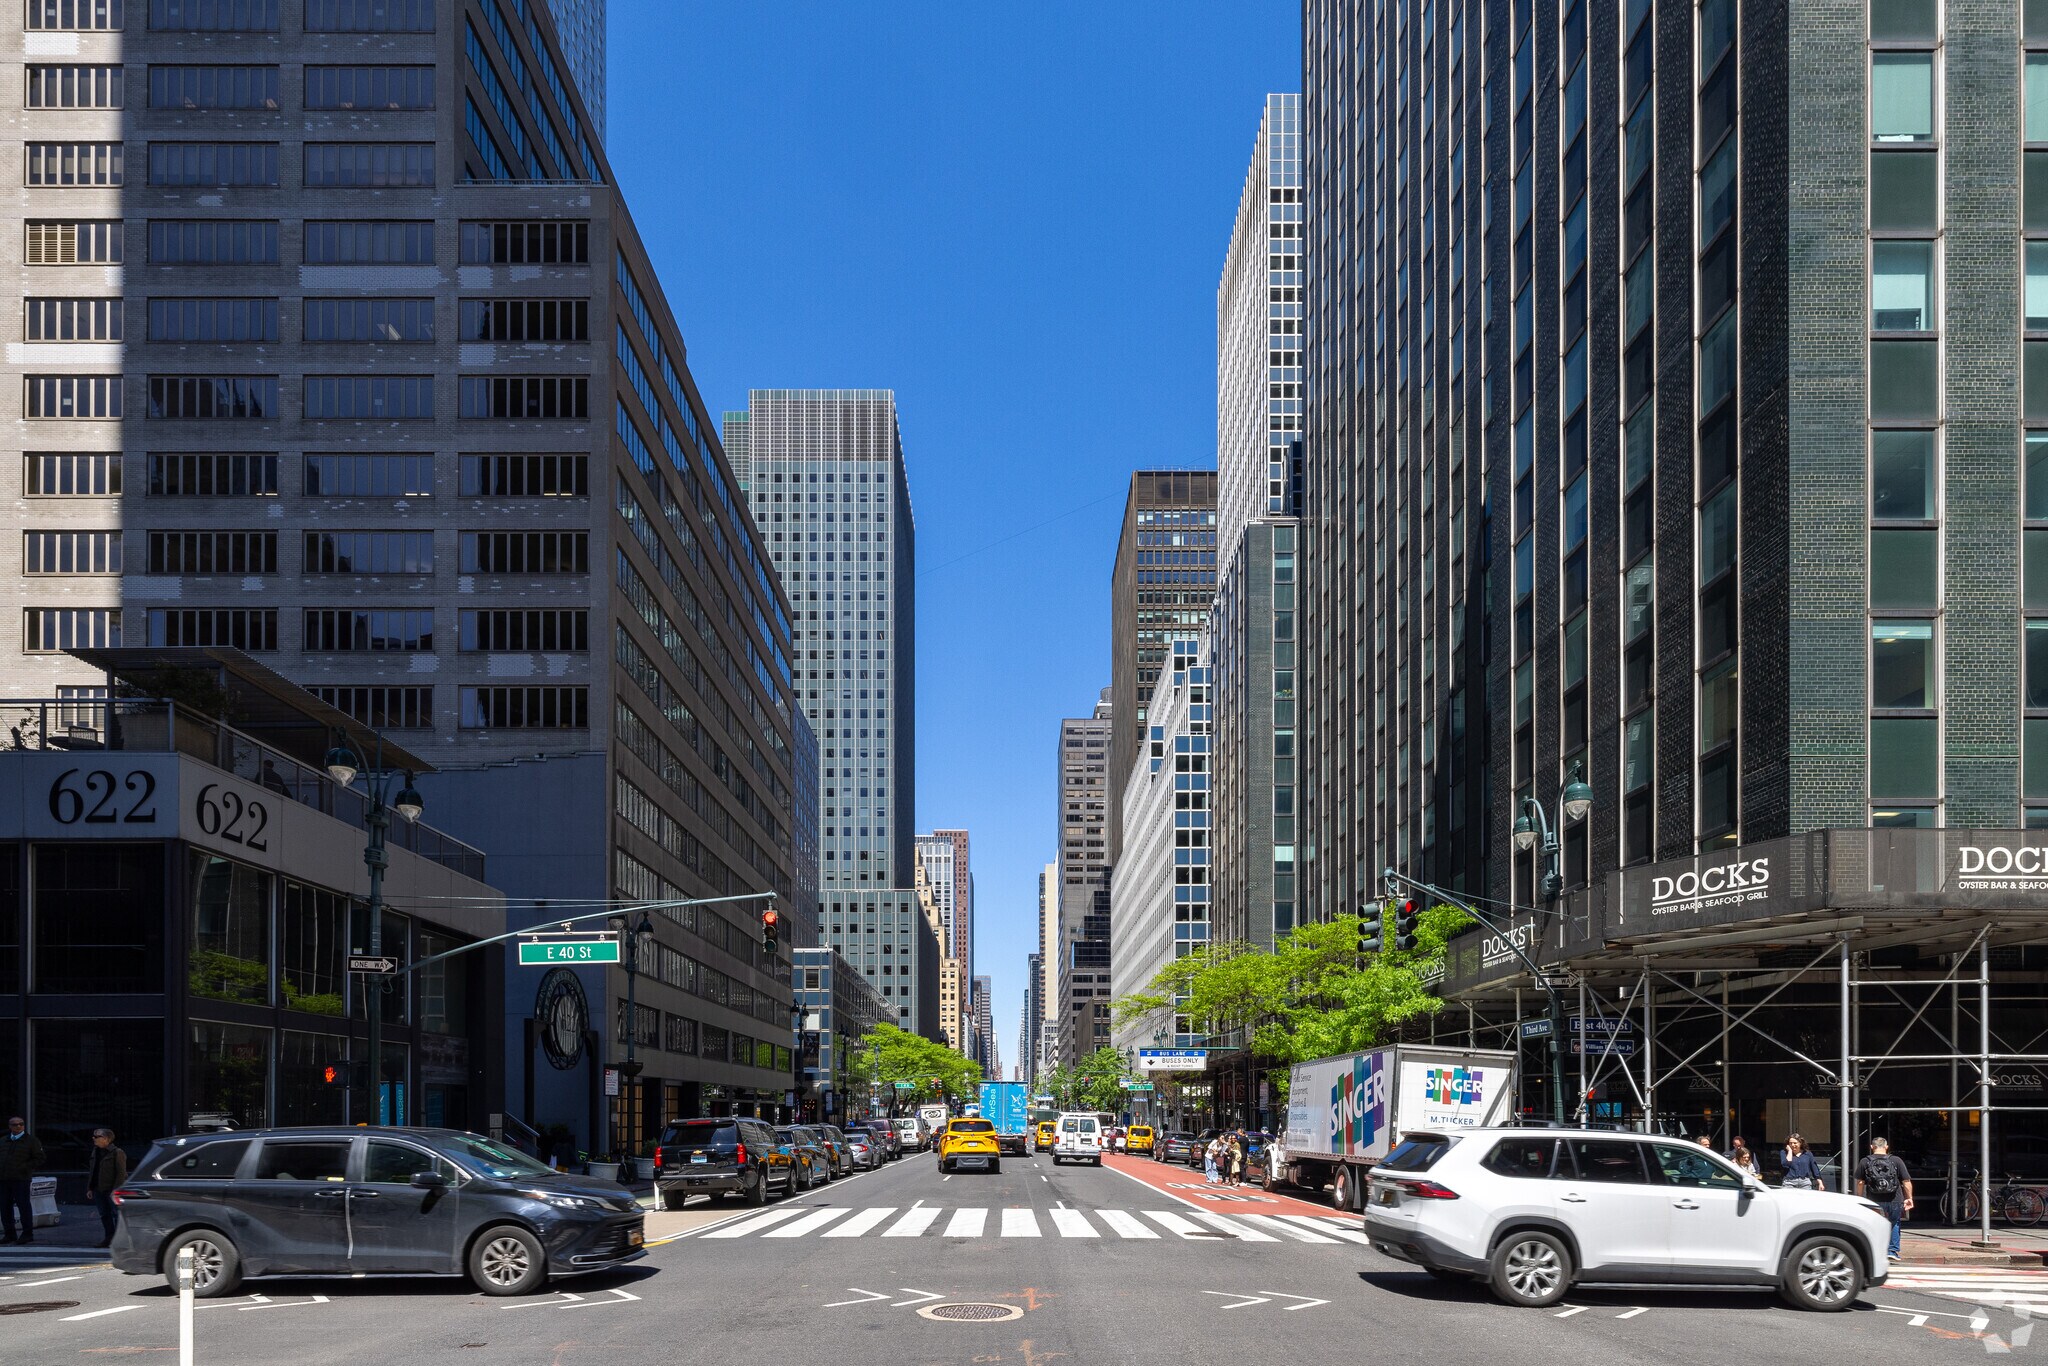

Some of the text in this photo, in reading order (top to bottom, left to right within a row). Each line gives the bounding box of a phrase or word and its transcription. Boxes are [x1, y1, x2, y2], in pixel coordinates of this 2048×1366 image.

[49, 768, 156, 824] 622
[196, 784, 268, 852] 622
[1959, 847, 2048, 873] DOC
[1652, 857, 1770, 901] DOCKS
[1959, 881, 2048, 890] OYSTER BAR & SEAFO
[1651, 891, 1769, 916] OYSTER BAR & SEAFOOD GRILL
[1482, 926, 1526, 958] DOCKS
[547, 946, 591, 959] E 40 St
[1525, 1024, 1548, 1034] Third Ave
[1574, 1020, 1594, 1030] Est
[1426, 1077, 1483, 1093] SINGER
[1815, 1074, 1868, 1085] DOS
[1330, 1069, 1385, 1137] SINGER
[1165, 1182, 1240, 1191] ONLY
[1192, 1193, 1279, 1203] BUS
